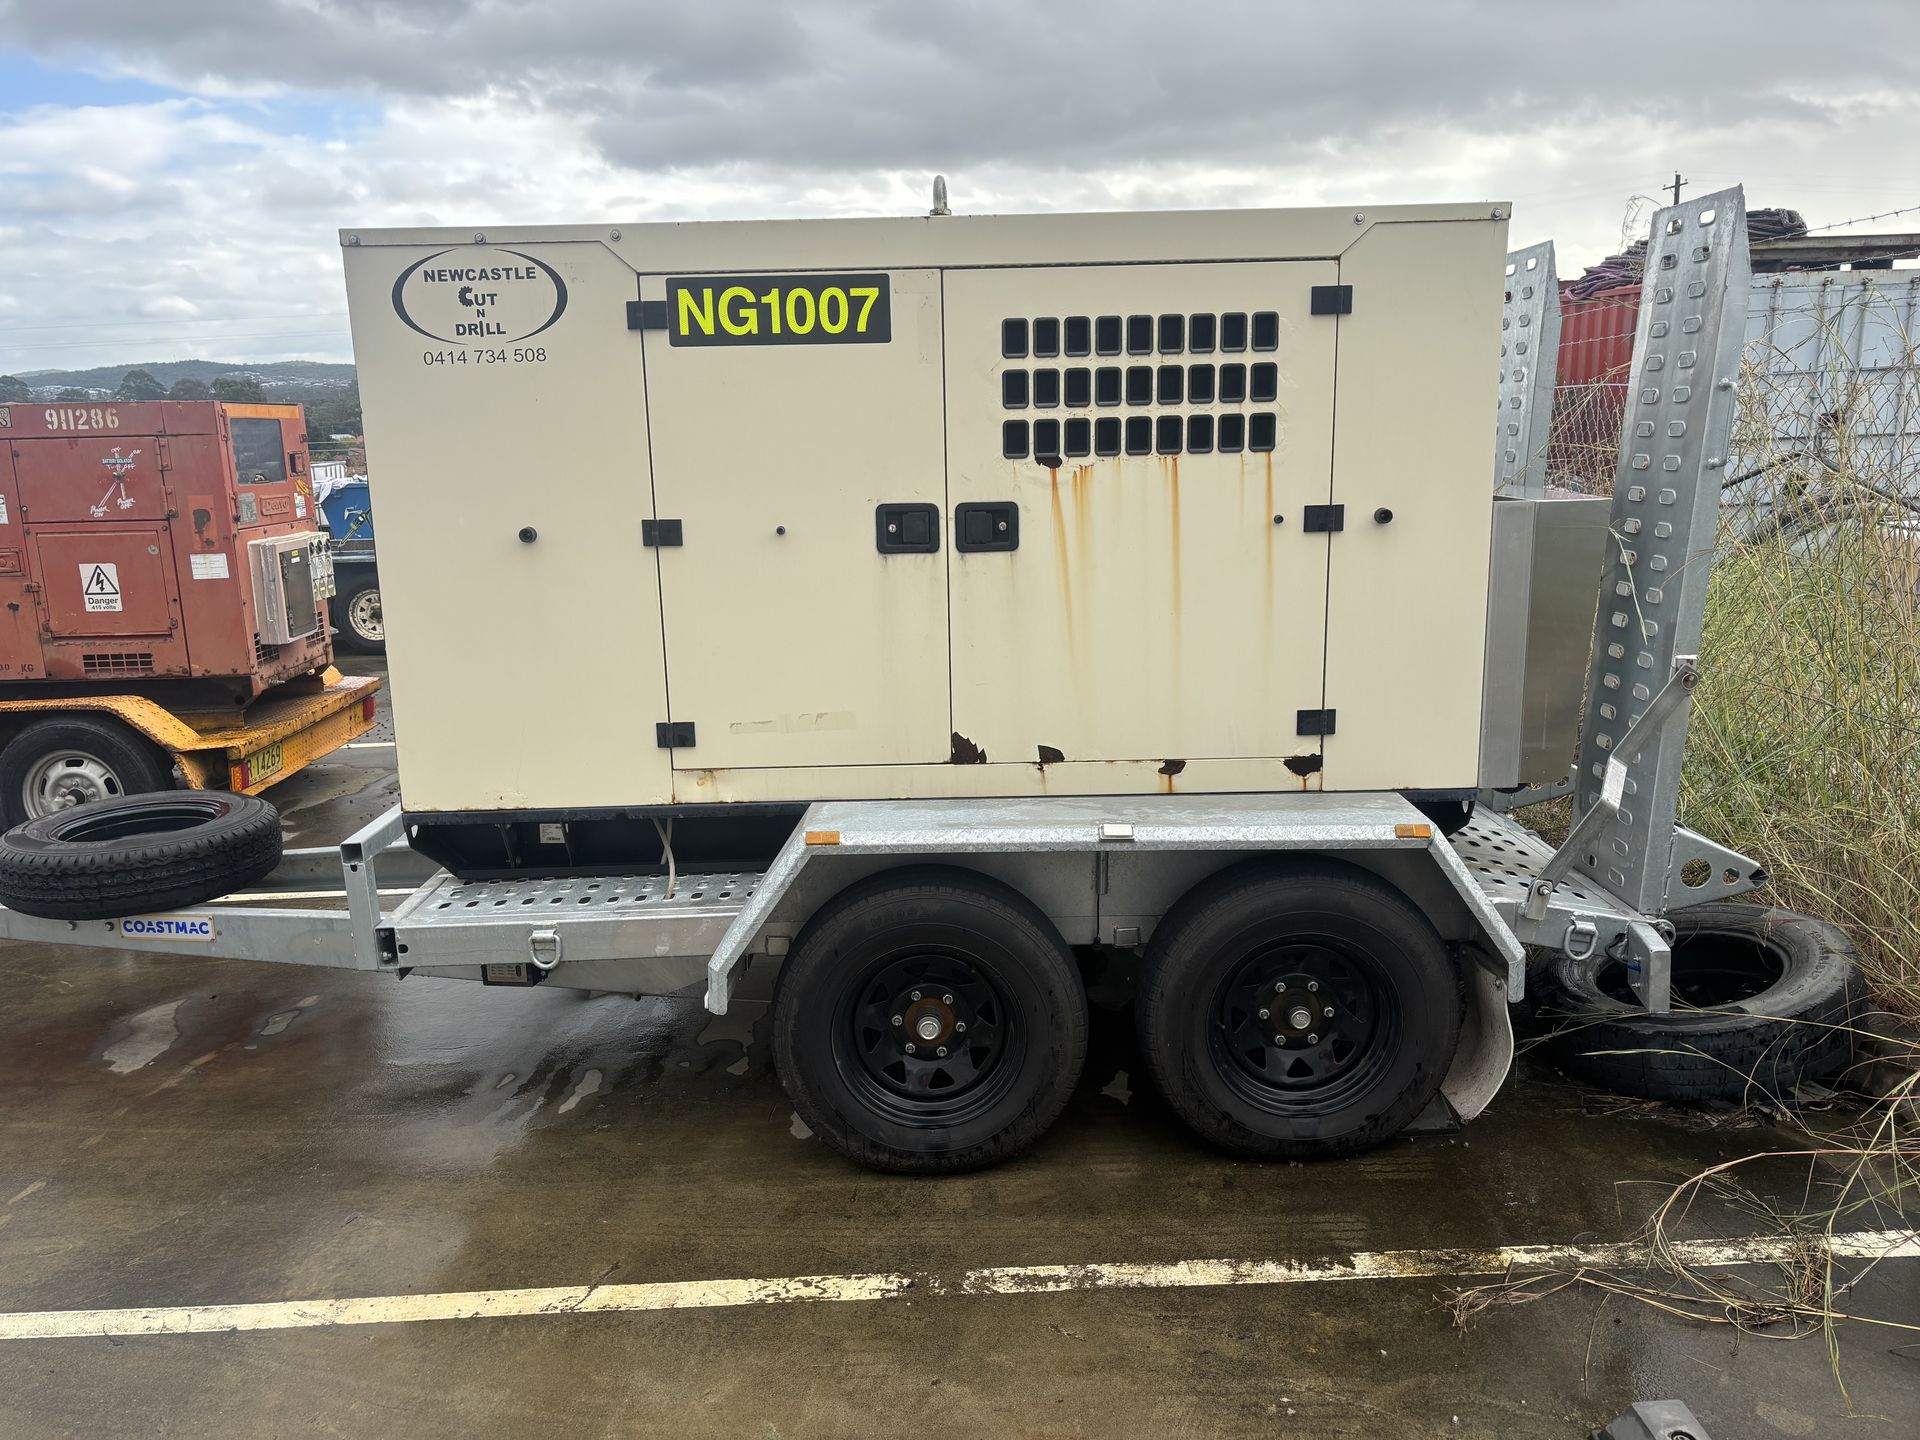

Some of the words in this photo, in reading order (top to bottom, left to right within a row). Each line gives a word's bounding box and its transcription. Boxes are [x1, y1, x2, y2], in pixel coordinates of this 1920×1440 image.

[423, 267, 537, 283] NEWCASTLE
[458, 285, 498, 308] CUT
[476, 308, 486, 319] N
[676, 285, 880, 336] NG1007
[455, 320, 507, 338] DRILL
[423, 350, 468, 366] 0414
[473, 349, 507, 364] 734
[513, 347, 547, 363] 508
[44, 407, 119, 431] 911286
[87, 597, 119, 605] Danger
[20, 663, 35, 673] KG
[122, 920, 210, 935] COASTMAC
